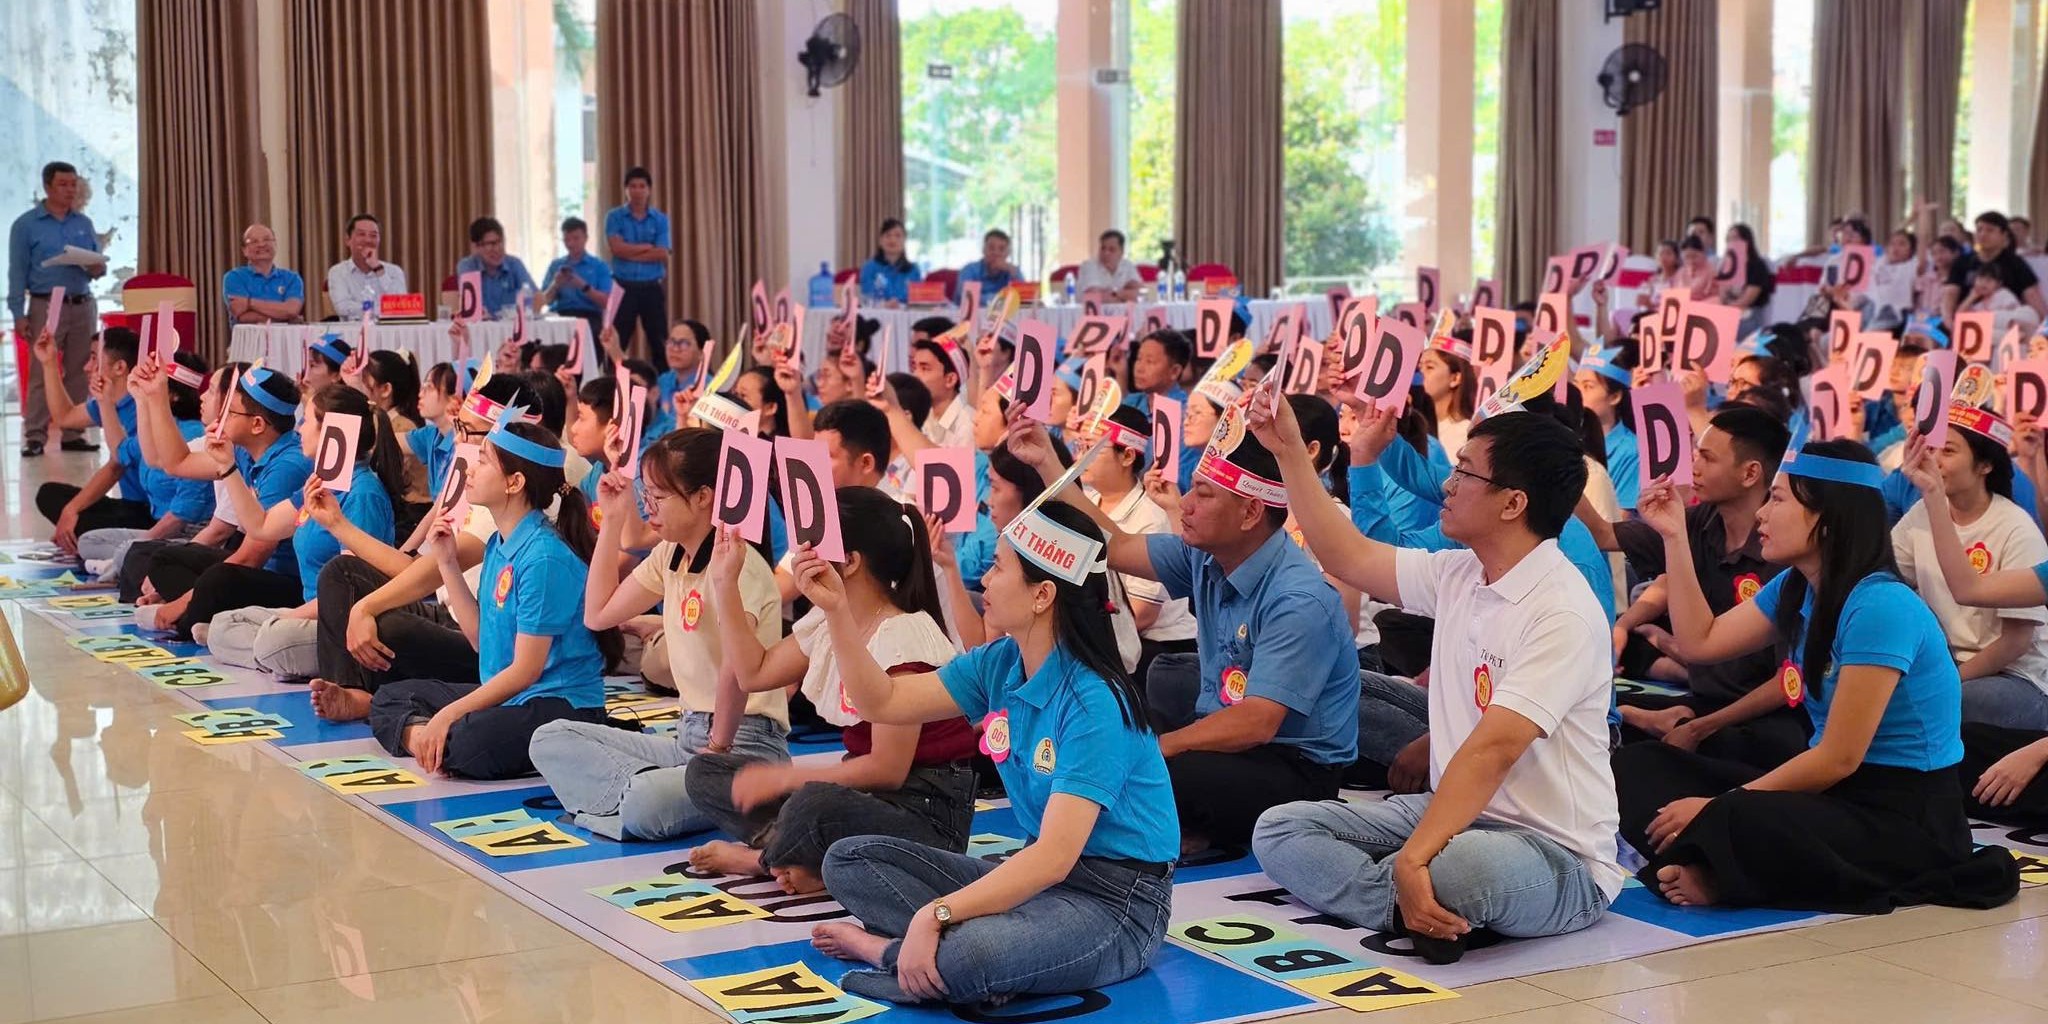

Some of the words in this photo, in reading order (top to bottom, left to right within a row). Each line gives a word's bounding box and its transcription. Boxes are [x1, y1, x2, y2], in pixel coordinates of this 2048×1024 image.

[1572, 252, 1599, 278] D
[1845, 253, 1864, 285] D
[462, 282, 476, 318] D
[1661, 298, 1680, 336] D
[1073, 321, 1109, 349] D
[1202, 309, 1221, 352] D
[1344, 313, 1367, 372] D
[1479, 318, 1505, 363] D
[1643, 326, 1656, 368] D
[1680, 314, 1719, 371] D
[1832, 319, 1849, 354] D
[1959, 321, 1983, 355] D
[1015, 334, 1043, 405] D
[1293, 348, 1314, 393] D
[1364, 331, 1402, 398] D
[1855, 348, 1882, 391] D
[1078, 368, 1097, 416] D
[2015, 372, 2046, 419] D
[317, 426, 347, 481] D
[1154, 409, 1171, 469] D
[1642, 403, 1680, 479] D
[442, 456, 468, 509] D
[719, 448, 753, 524] D
[786, 458, 825, 545] D
[923, 462, 961, 523] D
[1027, 531, 1077, 571] THẮNG
[106, 649, 169, 658] A
[152, 668, 210, 677] B
[164, 676, 224, 686] C
[1231, 680, 1244, 693] 012
[216, 719, 281, 730] B
[992, 728, 1007, 745] 001
[340, 773, 417, 787] A
[488, 829, 571, 848] A
[659, 898, 753, 920] A
[1185, 922, 1275, 945] C
[1255, 949, 1353, 974] B
[720, 971, 825, 996] A
[1329, 972, 1438, 998] A
